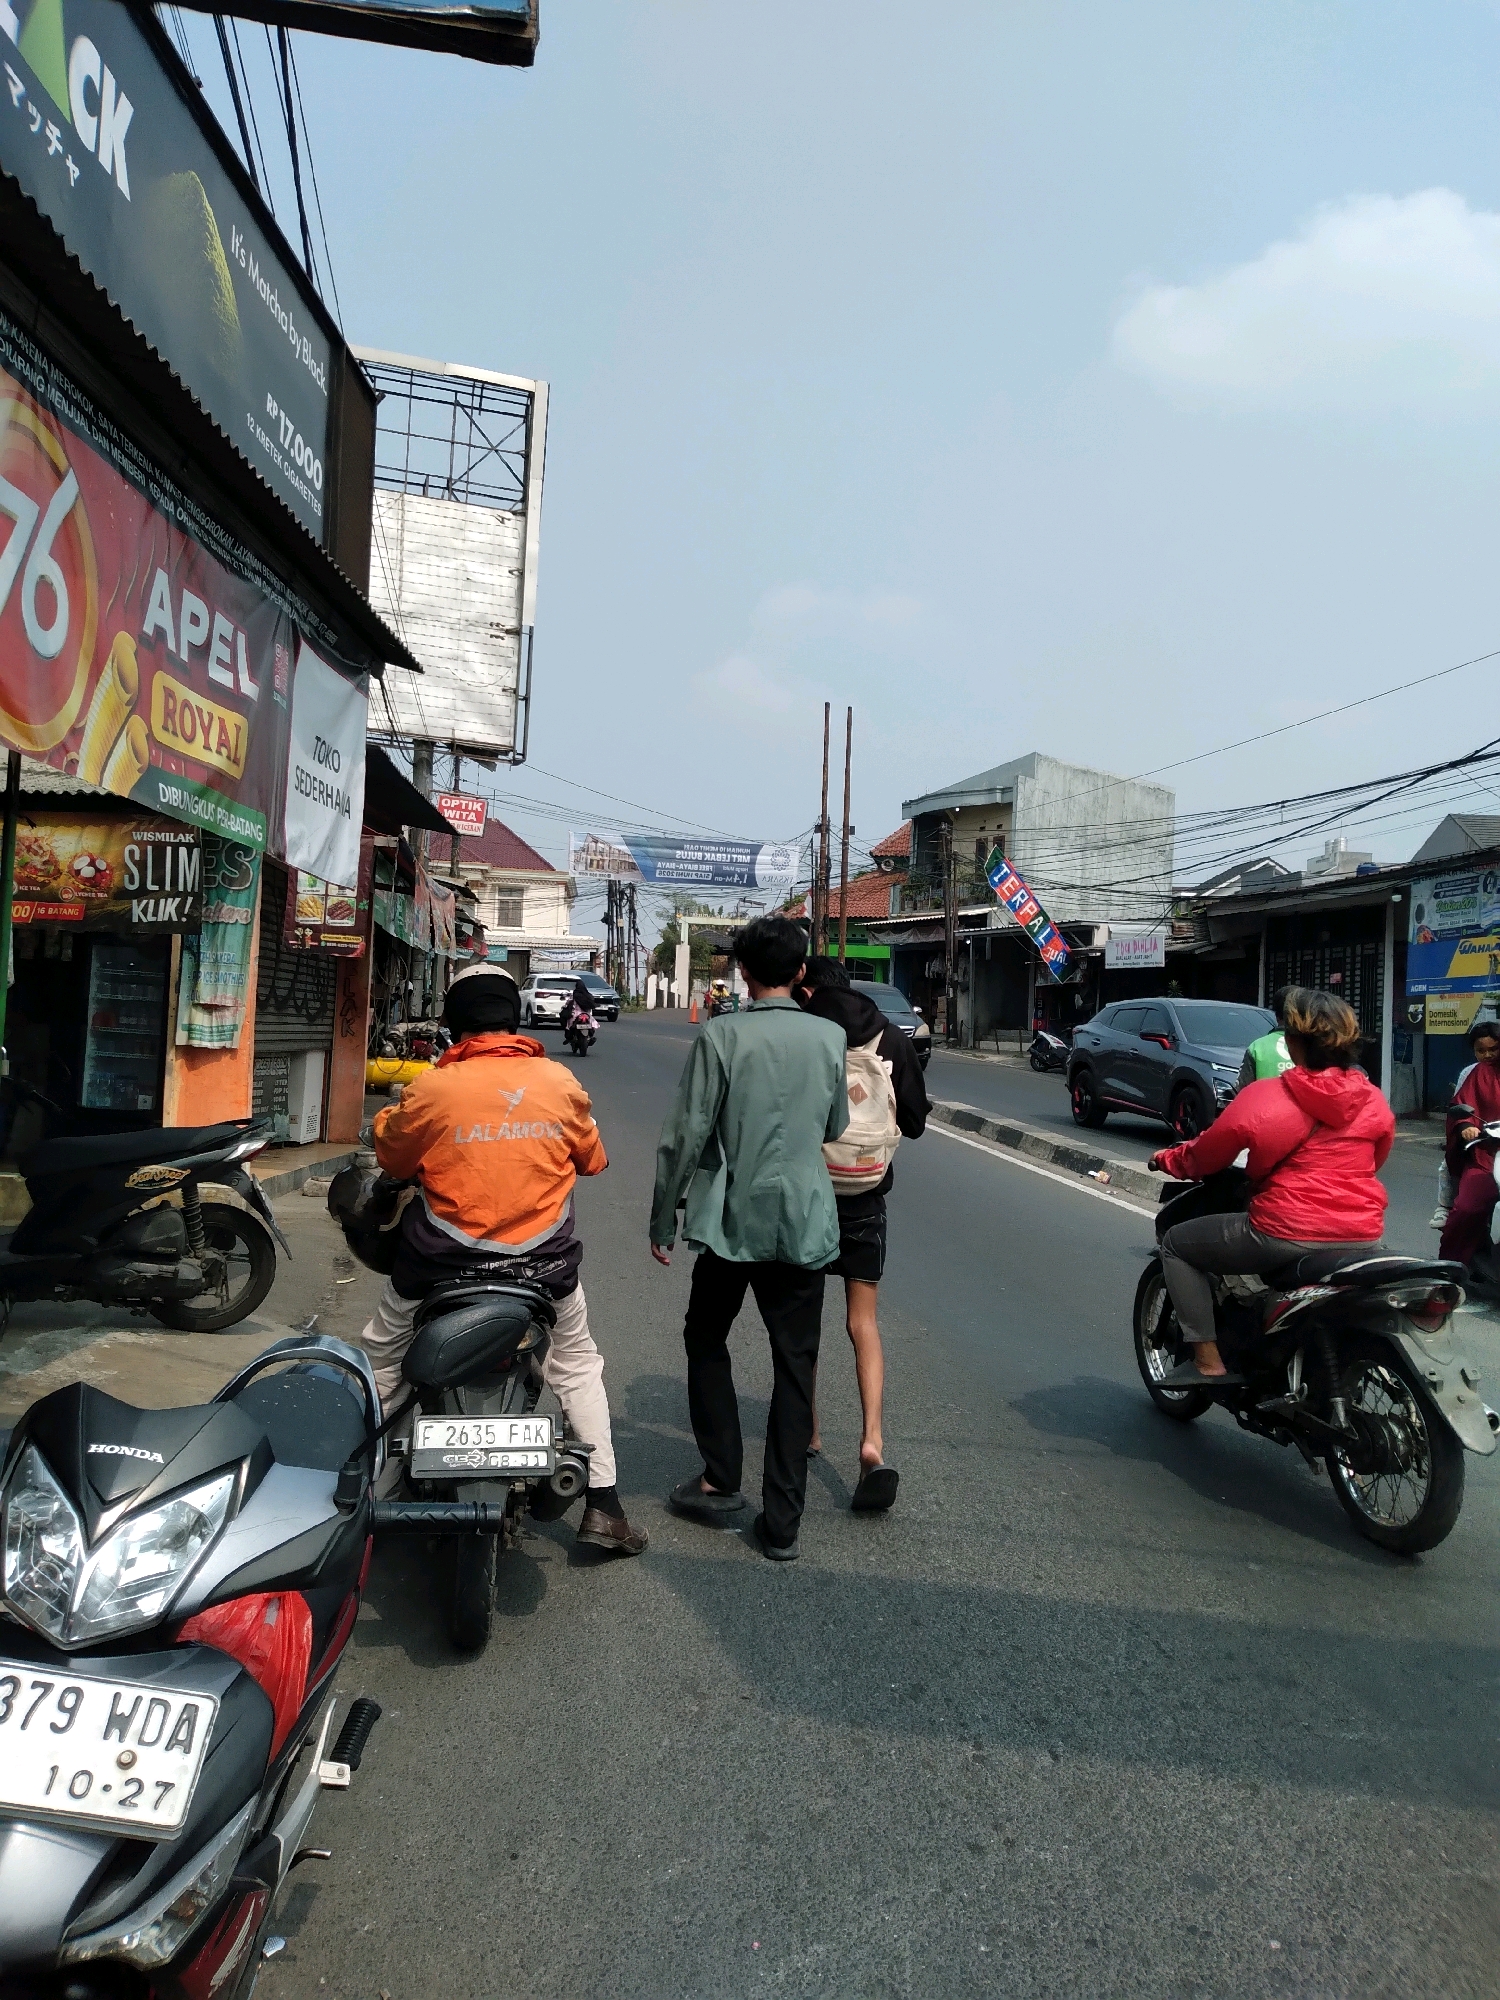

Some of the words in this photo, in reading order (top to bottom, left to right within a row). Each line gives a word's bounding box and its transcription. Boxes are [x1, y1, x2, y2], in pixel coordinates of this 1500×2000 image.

[231, 224, 246, 268] It's
[248, 251, 289, 334] Matcha
[289, 311, 302, 359] by
[0, 337, 45, 394] DILARANG
[47, 382, 91, 435] MENJUAL
[91, 425, 110, 452] DAN
[110, 444, 146, 488] MEMBERI
[148, 479, 175, 515] KEPADA
[11, 324, 49, 372] KARENA
[98, 411, 119, 443] SAYA
[120, 432, 155, 477] TERKENA
[234, 543, 263, 574] LAYANAN
[246, 412, 256, 434] 12
[256, 425, 282, 471] KRETEK
[283, 462, 322, 517] CIGARETTES
[279, 408, 323, 491] 17.000
[142, 566, 260, 702] APEL
[162, 685, 242, 767] ROYAL
[312, 735, 341, 774] TOKO
[294, 764, 351, 820] SEDERHANA
[441, 798, 482, 812] OPTIK
[158, 782, 216, 823] DIBUNGKUS
[216, 807, 263, 842] PER-BATANG
[443, 808, 477, 821] WITA
[132, 831, 195, 843] WISMILAK
[123, 844, 200, 893] SLIM
[37, 907, 45, 915] 16
[47, 907, 79, 916] BATANG
[131, 896, 194, 924] KLIK!
[992, 862, 1054, 947] TERPAL
[1043, 946, 1068, 966] JUAL
[1410, 984, 1427, 993] AGEN
[1428, 1009, 1458, 1018] Domestik
[1428, 1017, 1470, 1027] Internasional
[454, 1121, 565, 1144] LALAMOVE
[489, 1256, 532, 1271] pengiriman
[422, 1424, 435, 1447] F
[445, 1424, 496, 1447] 2635
[508, 1423, 545, 1445] FAK
[88, 1442, 165, 1464] HONDA
[103, 1691, 200, 1755] WDA
